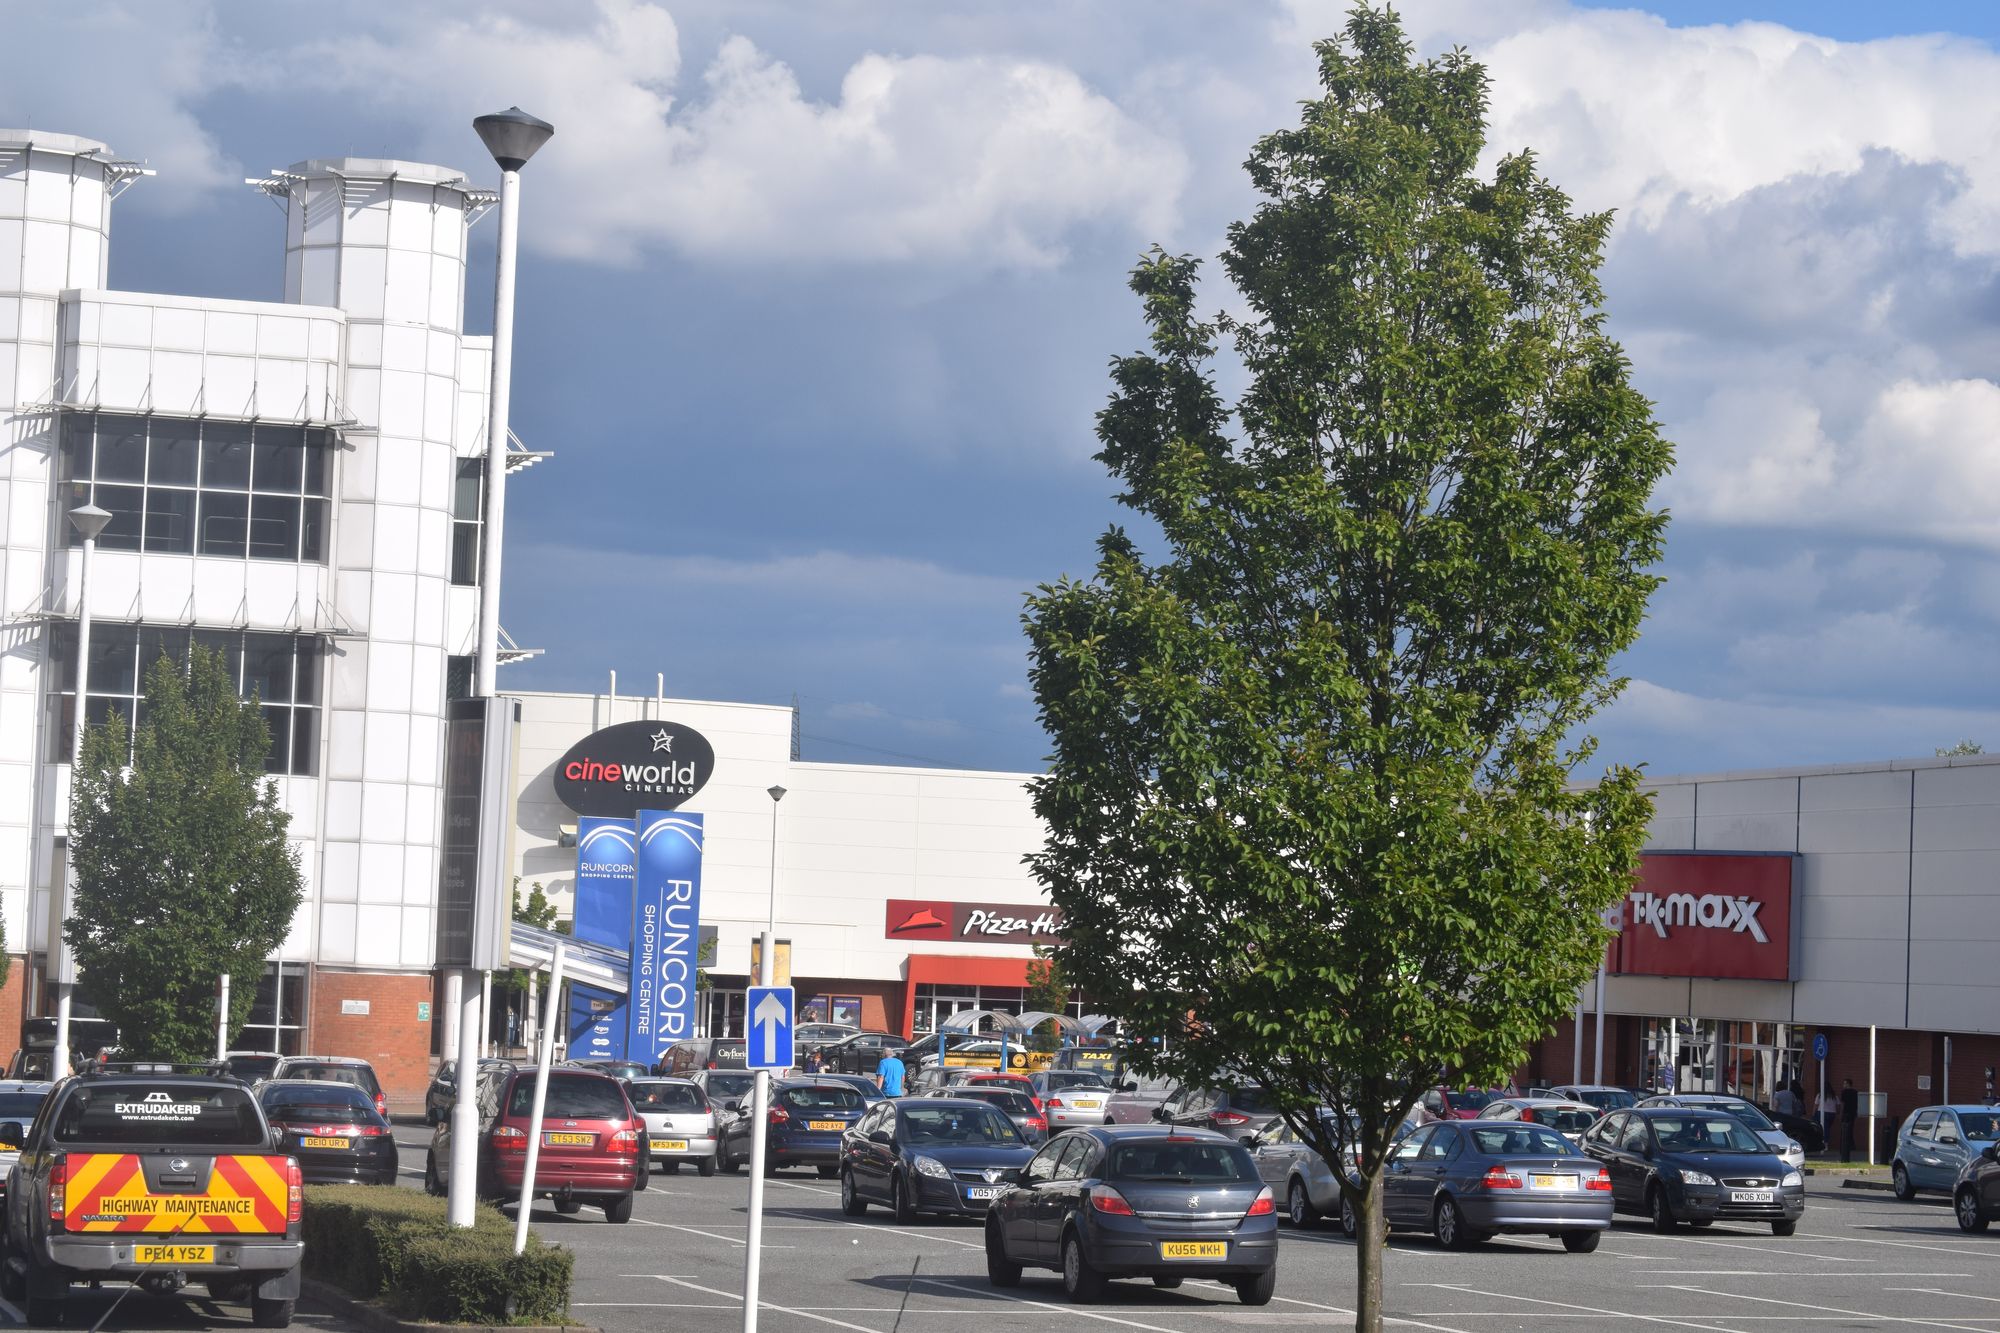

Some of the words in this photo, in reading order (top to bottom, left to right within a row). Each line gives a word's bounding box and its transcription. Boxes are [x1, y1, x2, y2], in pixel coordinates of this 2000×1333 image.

[566, 757, 695, 785] cineworld
[625, 784, 694, 794] CINEMAS
[962, 909, 1028, 935] Pizza
[641, 904, 656, 975] SHOPPING
[637, 979, 652, 1035] CENTRE
[115, 1103, 201, 1114] EXTRUDAKERB
[329, 1139, 346, 1147] URX
[551, 1134, 573, 1143] ET53
[102, 1199, 158, 1213] HIGHWAY
[165, 1200, 250, 1213] MAINTENANCE
[81, 1214, 126, 1222] NAVARA
[144, 1248, 174, 1260] PE14
[179, 1248, 205, 1260] YSZ
[1168, 1245, 1197, 1255] KU56
[1199, 1245, 1220, 1255] WKH
